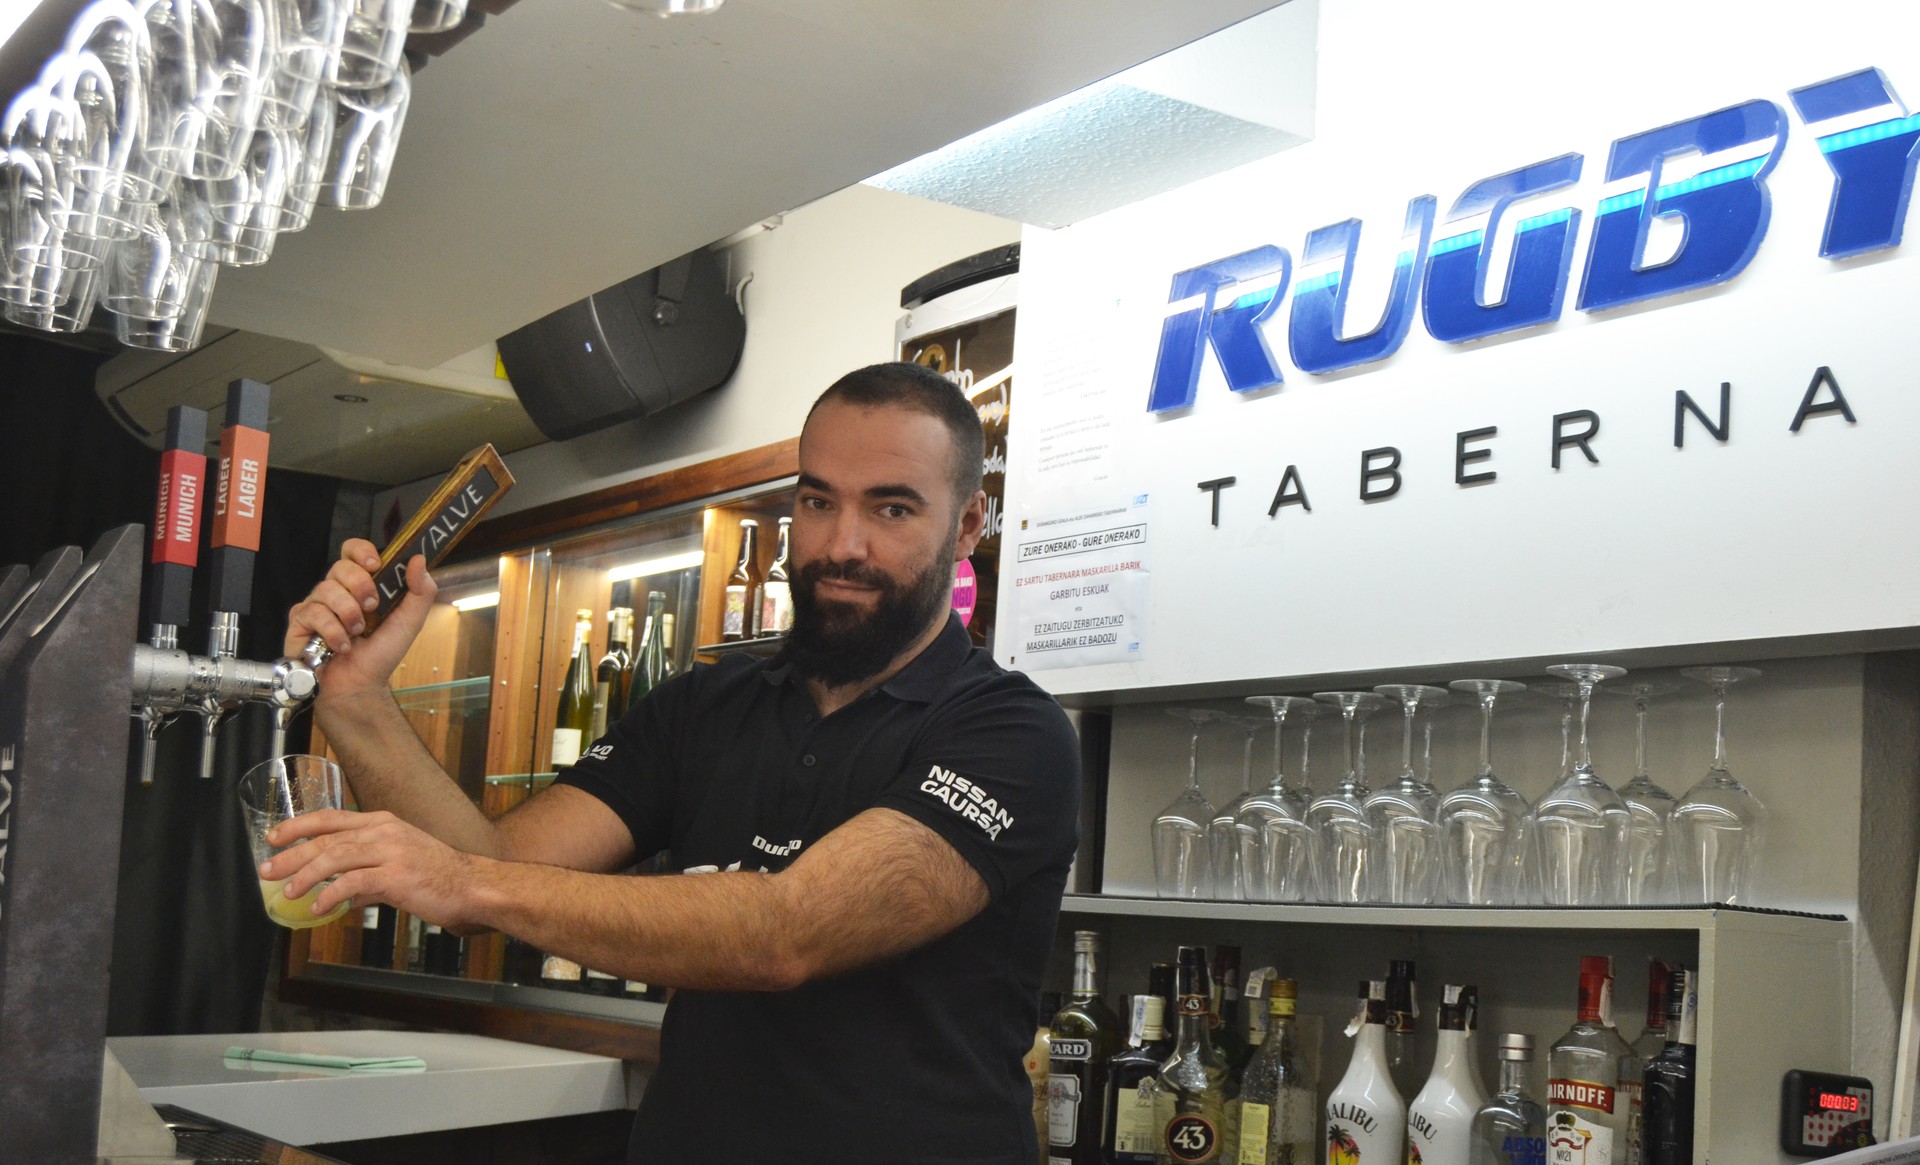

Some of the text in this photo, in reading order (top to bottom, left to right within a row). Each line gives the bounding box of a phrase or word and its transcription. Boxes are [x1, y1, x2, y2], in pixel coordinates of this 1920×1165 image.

[1146, 66, 1920, 415] RUGBY
[1198, 365, 1857, 527] TABERNA
[217, 457, 230, 515] LAGER
[237, 458, 259, 518] LAGER
[157, 472, 170, 540] MUNICH
[176, 473, 197, 543] MUNICH
[1023, 544, 1042, 557] ZURE
[1044, 540, 1077, 554] ONERAKO
[1082, 535, 1102, 547] GURE
[1104, 529, 1140, 544] ONERAKO
[1016, 561, 1141, 587] EZ SARTU TABERNARA MASKARILLA BARIK
[1050, 584, 1110, 600] GARBITU ESKUAK
[1034, 614, 1124, 634] EZ ZAITUGU ZERBITZATUKO
[1026, 632, 1118, 651] MASKARILLARIK EZ BADOZU
[920, 780, 1001, 841] GAURSA
[928, 765, 1014, 829] NISSAN
[1186, 999, 1200, 1009] 43
[1050, 1043, 1085, 1056] CARD
[1820, 1093, 1858, 1111] 00003
[1173, 1126, 1206, 1149] 43
[1408, 1110, 1438, 1140] LIBU
[1502, 1136, 1546, 1154] ABSO
